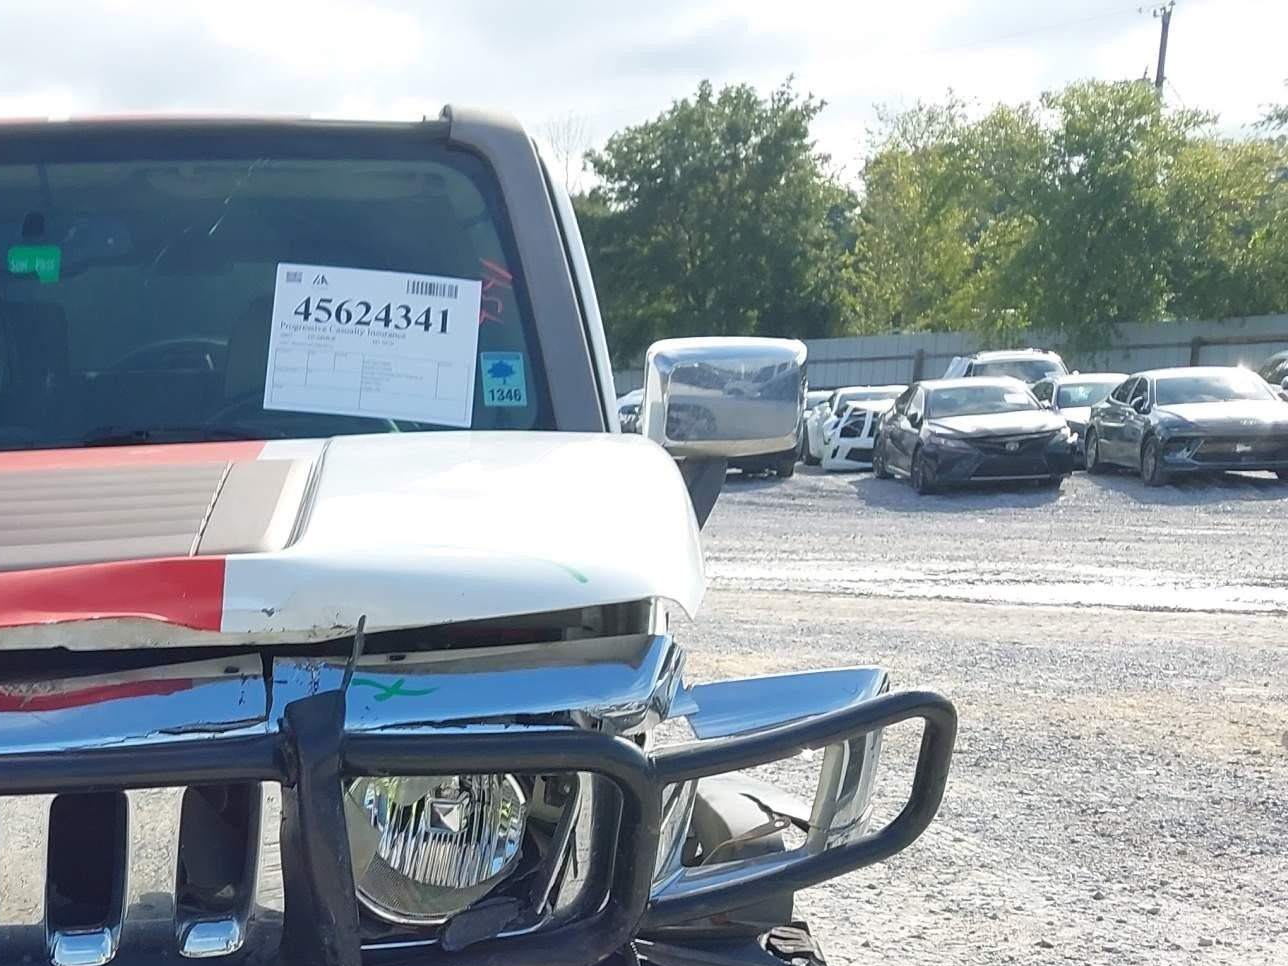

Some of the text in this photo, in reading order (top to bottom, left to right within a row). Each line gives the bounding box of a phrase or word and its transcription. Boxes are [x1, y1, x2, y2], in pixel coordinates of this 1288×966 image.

[279, 320, 407, 340] Progressive Casualty Insurance
[294, 295, 450, 335] 45624341
